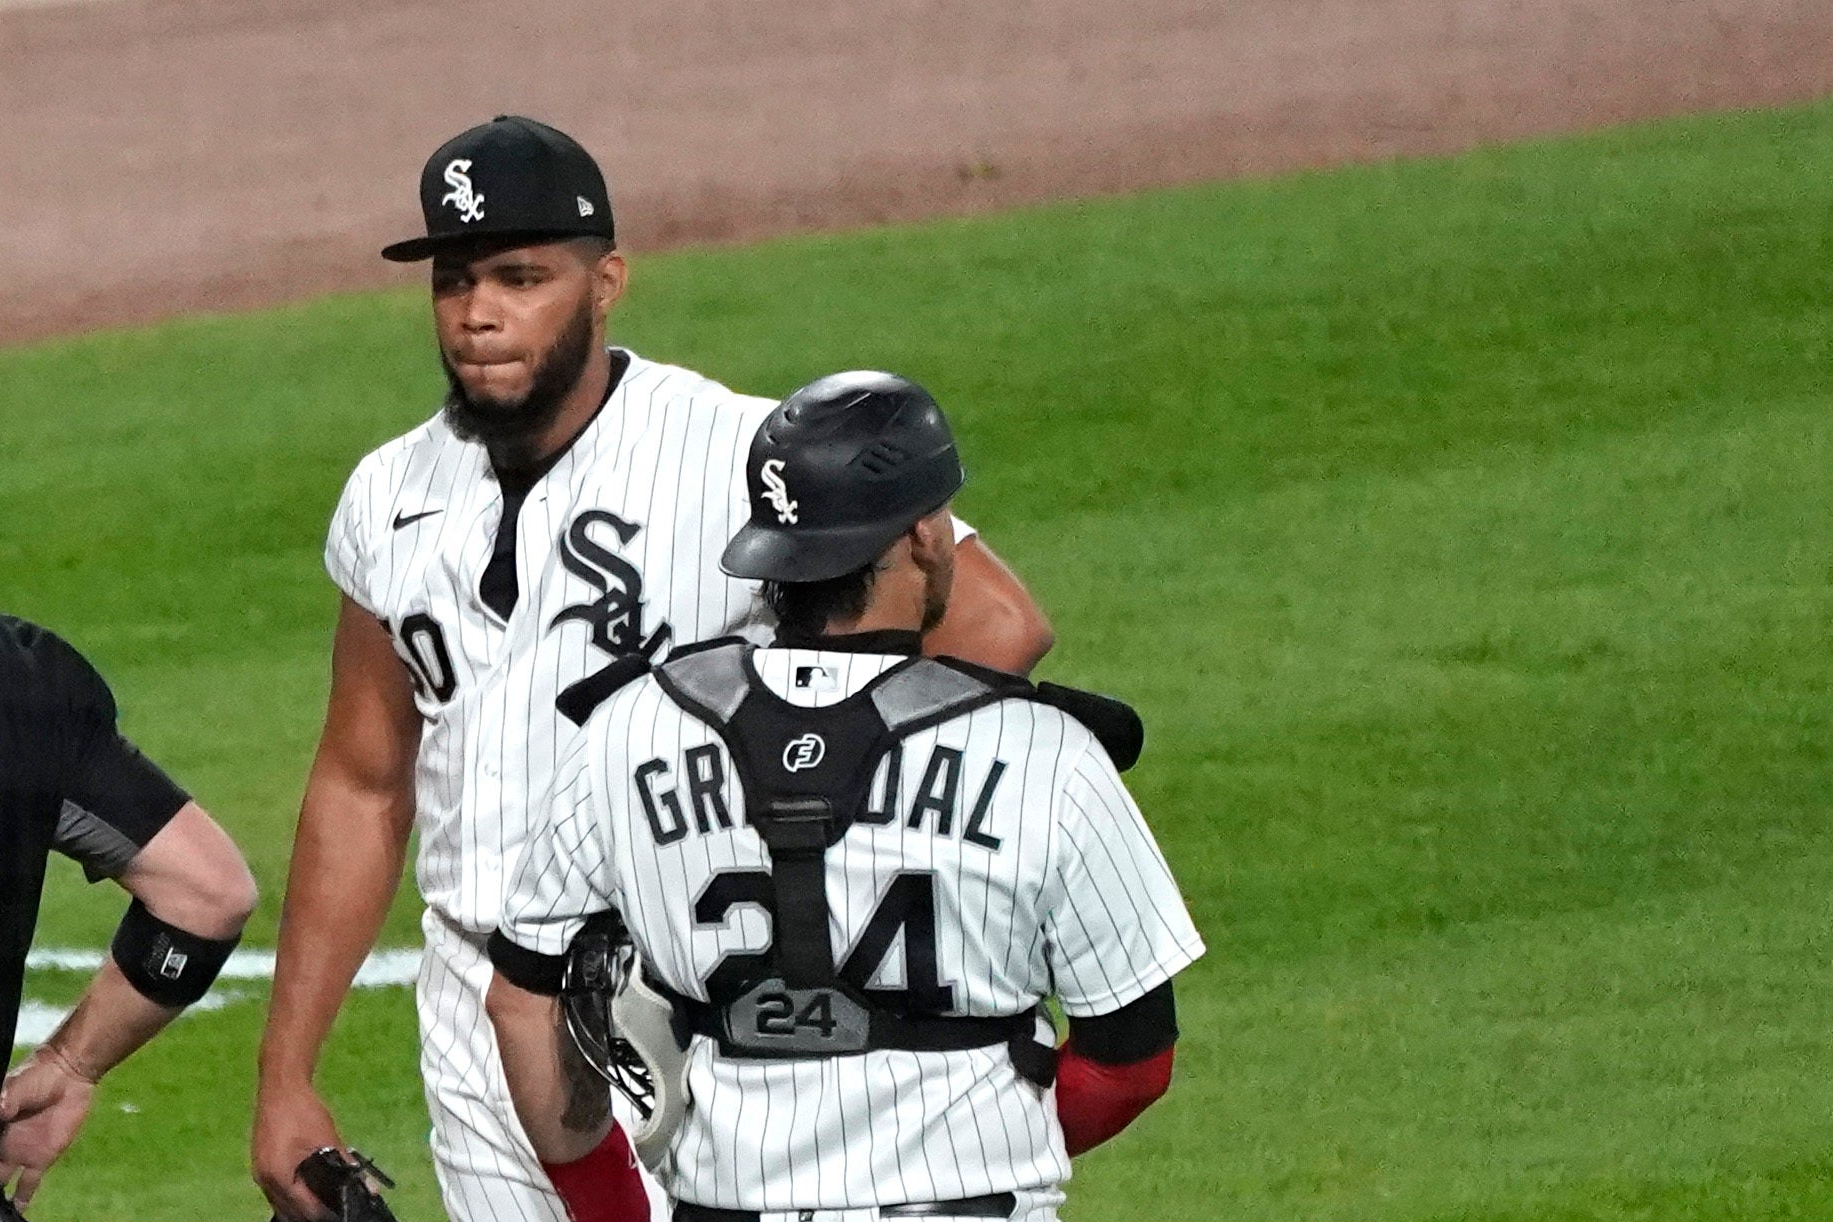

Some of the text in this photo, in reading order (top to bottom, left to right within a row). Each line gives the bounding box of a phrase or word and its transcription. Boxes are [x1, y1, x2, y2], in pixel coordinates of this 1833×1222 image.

[634, 742, 1009, 854] GRDAL
[694, 869, 958, 1015] 24
[755, 991, 837, 1038] 24
